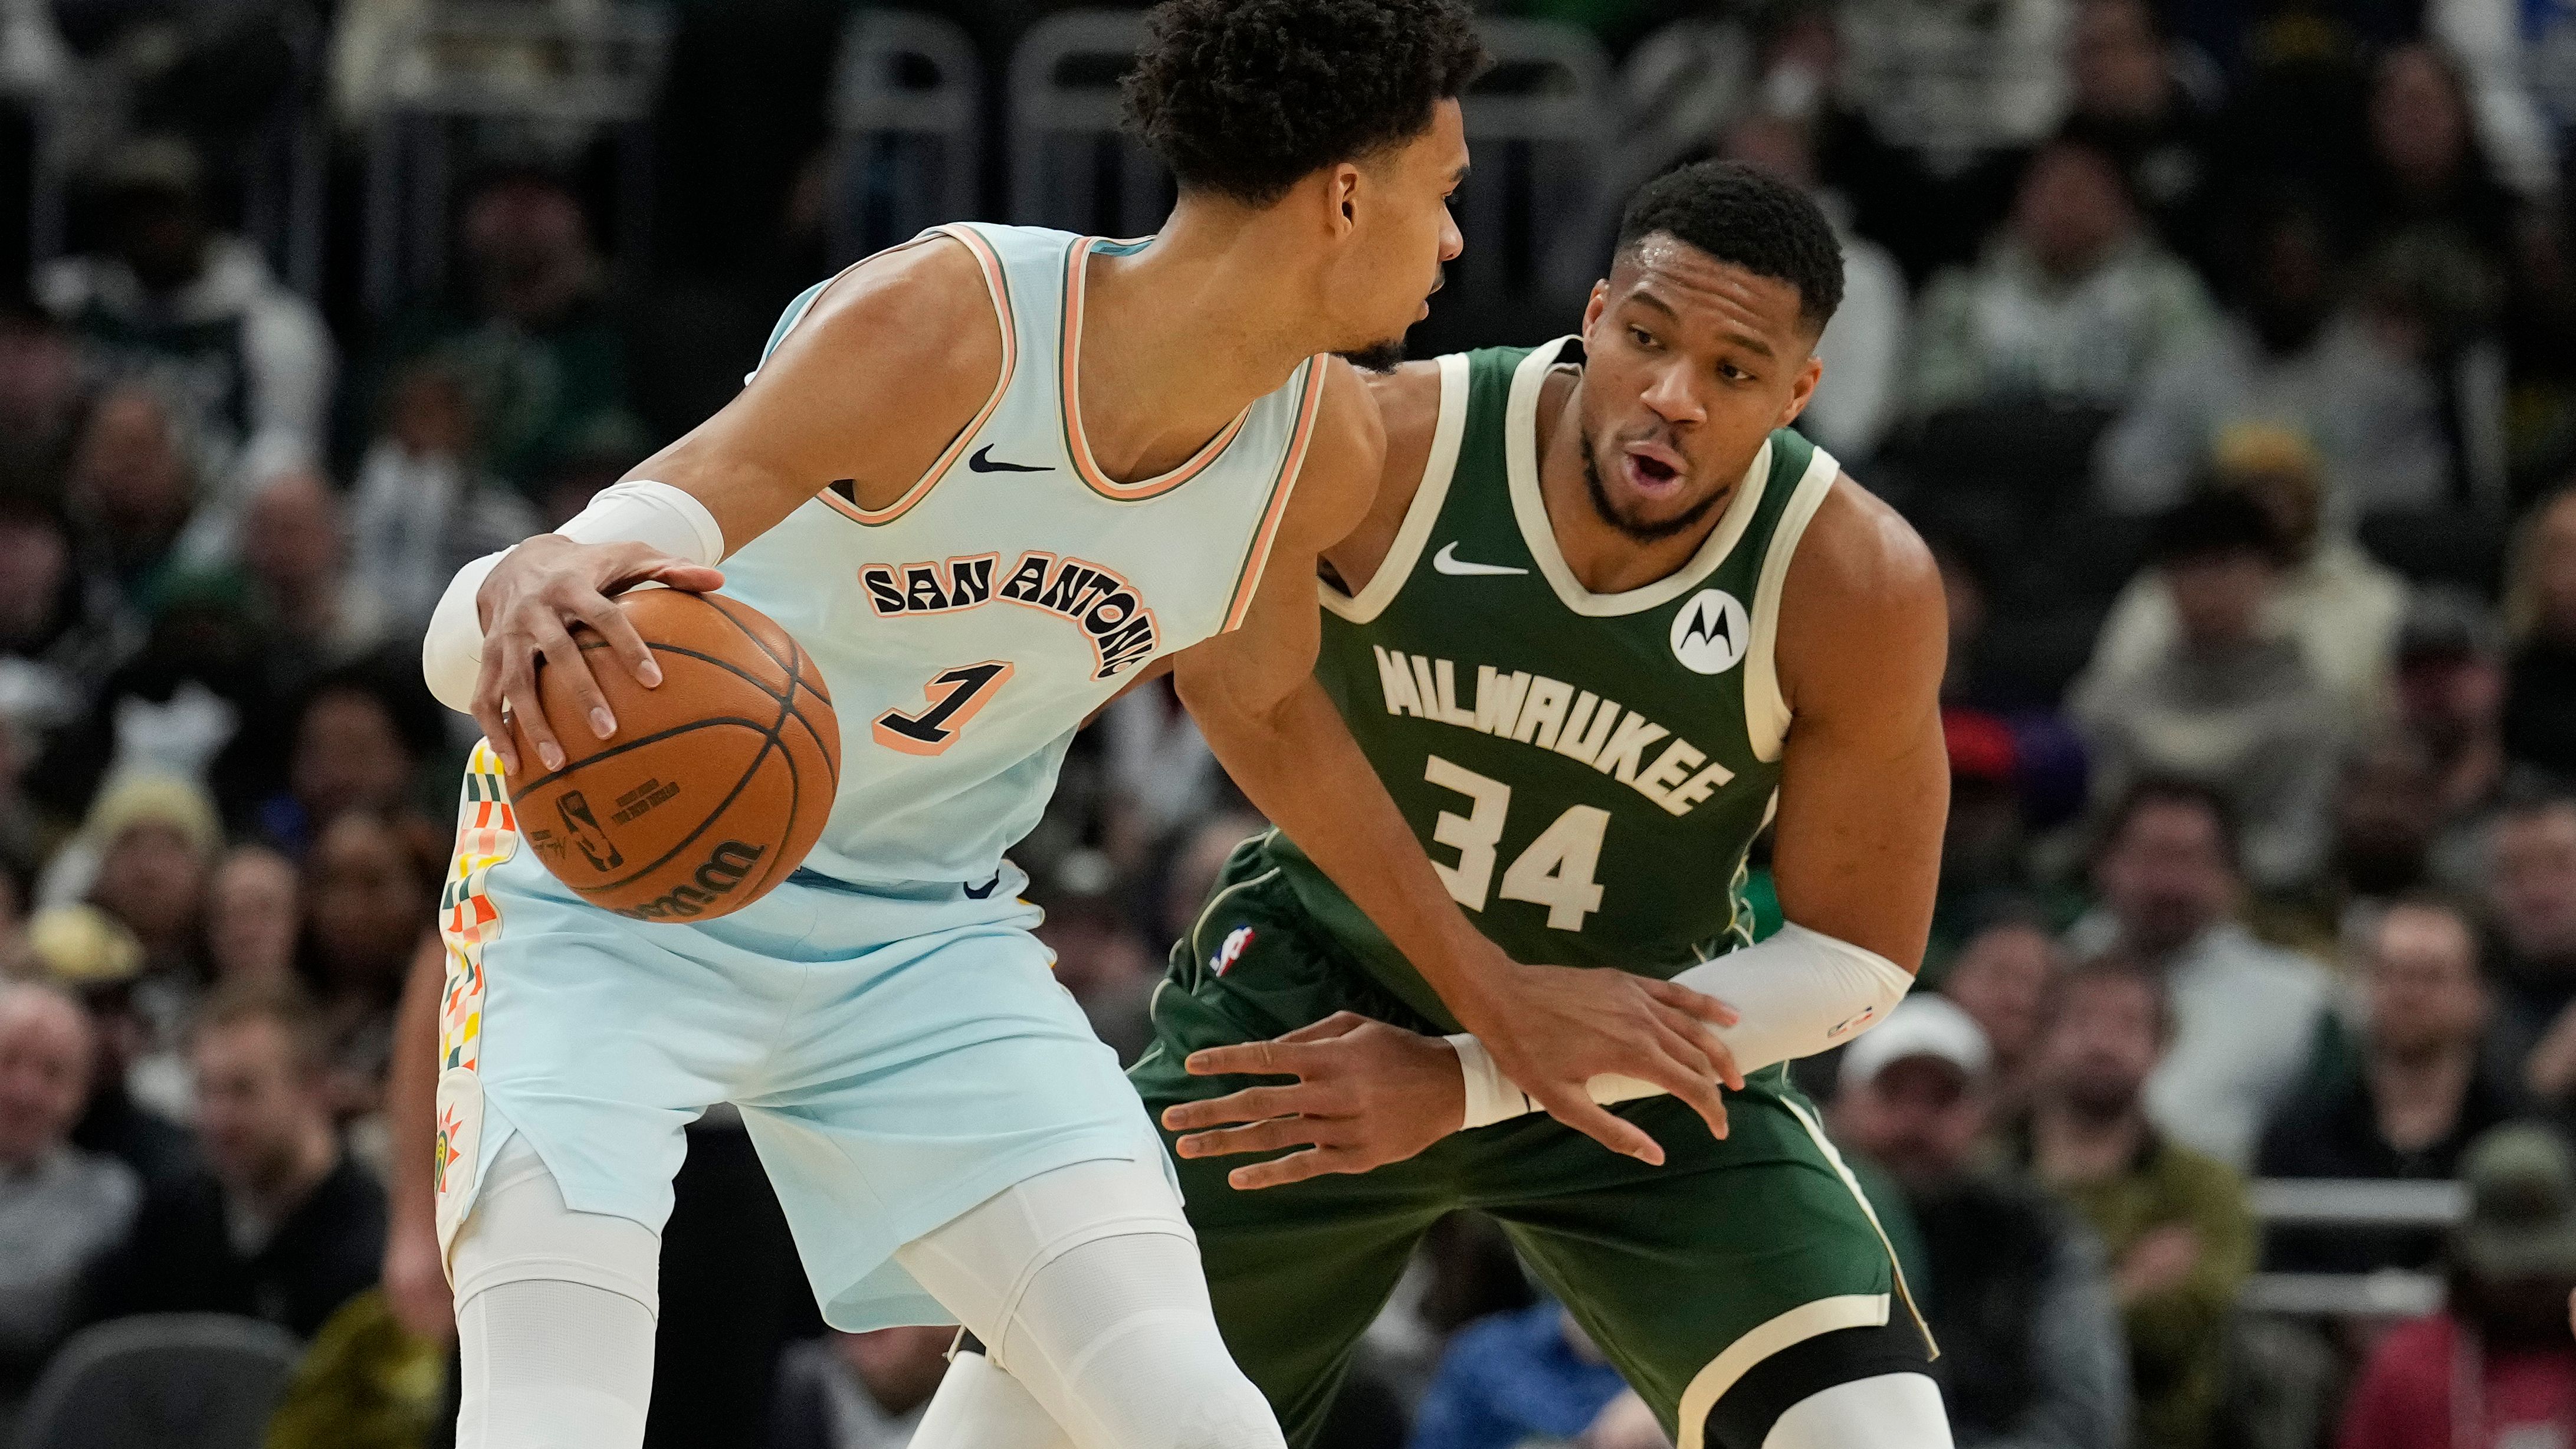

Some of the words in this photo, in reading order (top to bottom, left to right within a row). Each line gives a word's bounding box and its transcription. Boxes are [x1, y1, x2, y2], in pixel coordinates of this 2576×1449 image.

[858, 552, 999, 617] SAN
[871, 660, 1013, 755] 1
[1373, 644, 1735, 817] MILWAUKEE
[1423, 754, 1611, 932] 34
